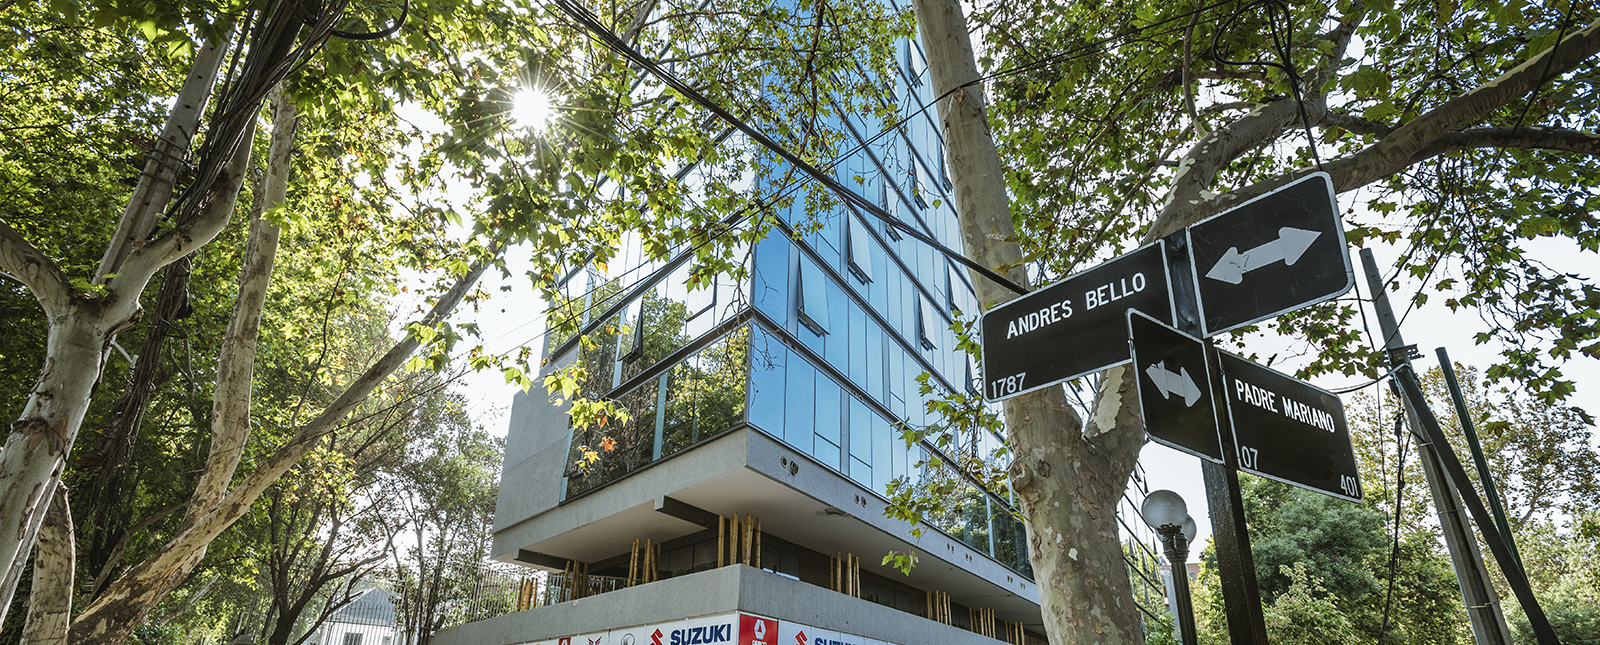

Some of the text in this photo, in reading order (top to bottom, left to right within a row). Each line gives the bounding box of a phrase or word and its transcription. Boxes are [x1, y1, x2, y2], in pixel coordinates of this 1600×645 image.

[1006, 272, 1146, 339] ANDRES BELLO
[992, 372, 1027, 398] 1787
[1235, 379, 1335, 433] PADRE MARIANO
[1341, 474, 1359, 497] 401
[670, 623, 732, 645] SUZUKI
